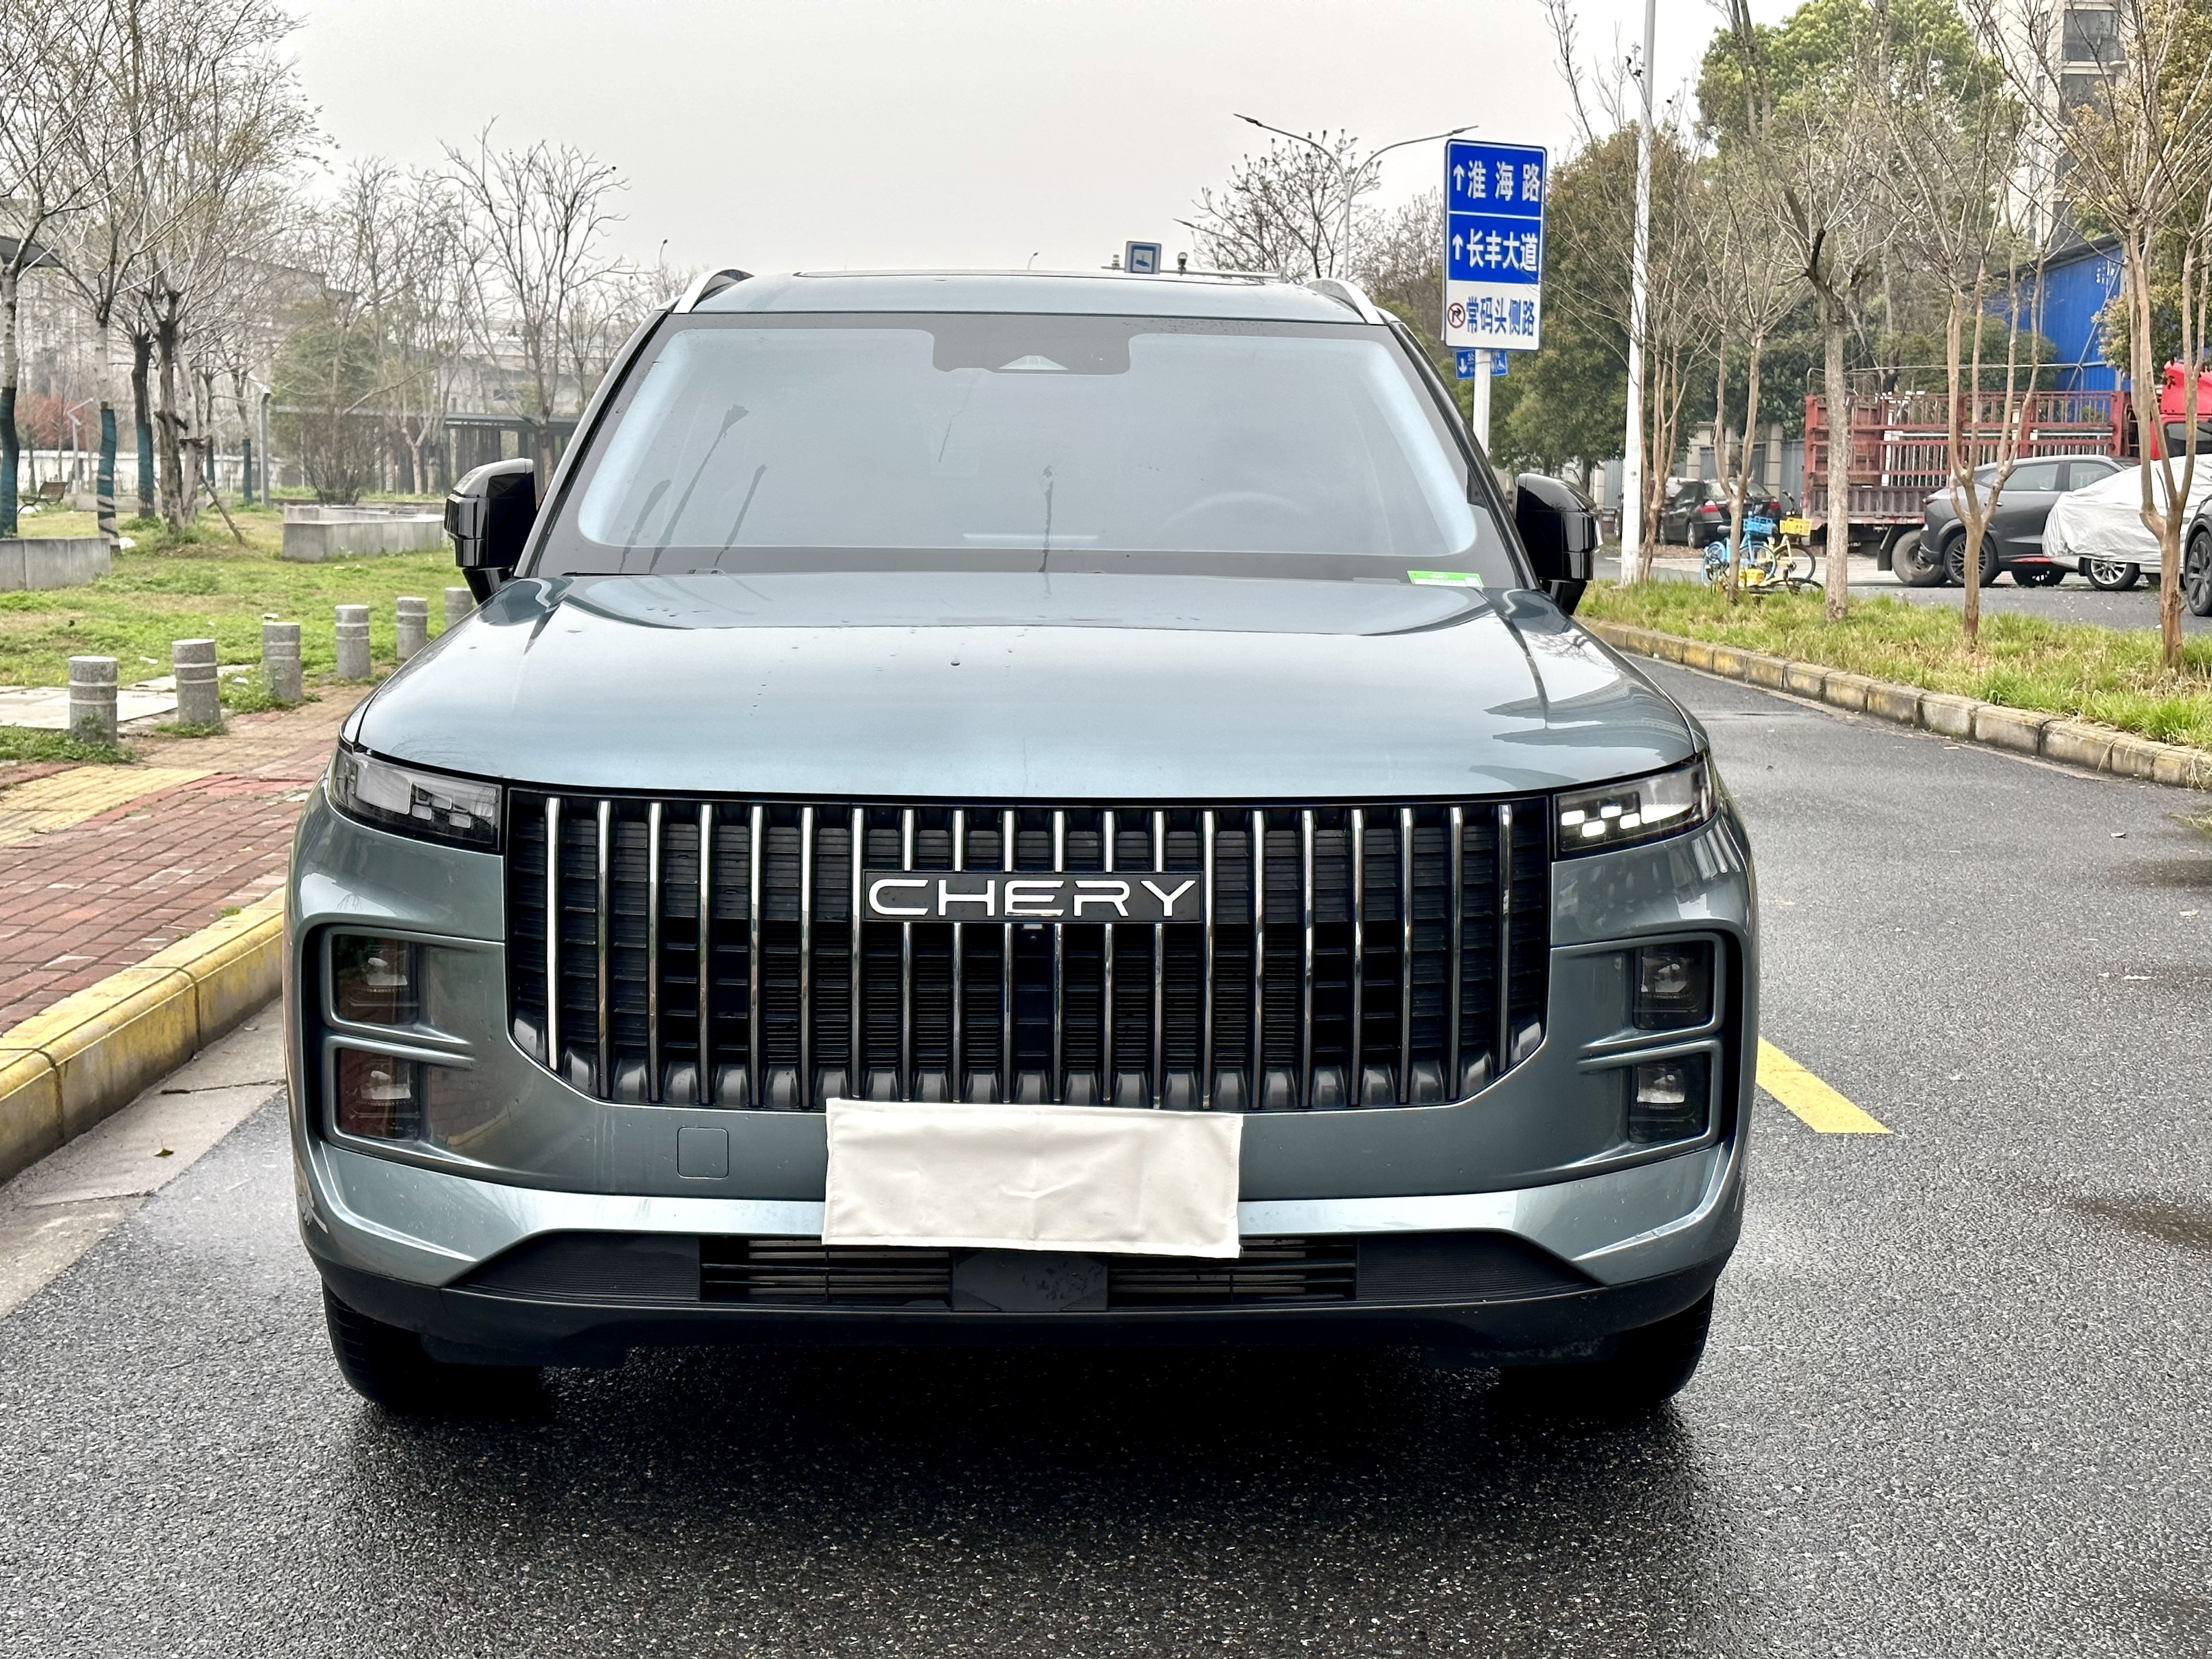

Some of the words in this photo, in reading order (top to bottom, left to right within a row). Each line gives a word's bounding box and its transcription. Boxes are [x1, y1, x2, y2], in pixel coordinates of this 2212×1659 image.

[1466, 160, 1540, 201] 淮海路
[1466, 228, 1538, 272] 长丰大道
[1466, 296, 1534, 337] 常码头侧路
[868, 878, 1196, 917] CHERY
